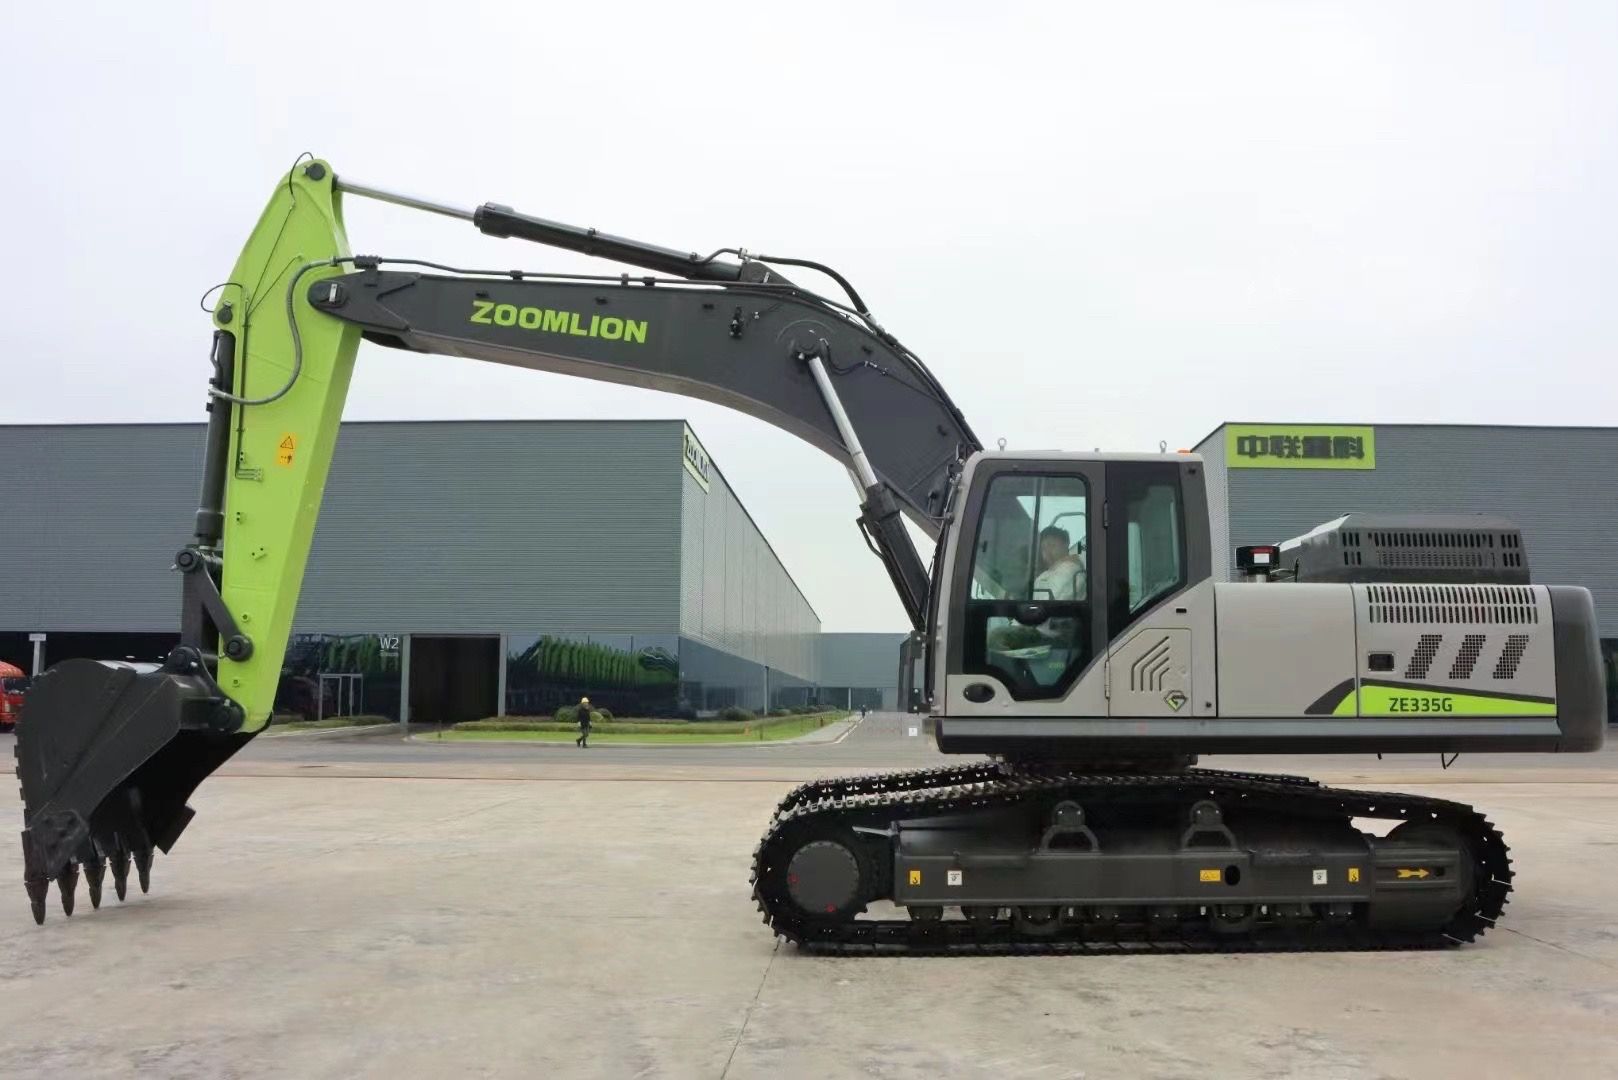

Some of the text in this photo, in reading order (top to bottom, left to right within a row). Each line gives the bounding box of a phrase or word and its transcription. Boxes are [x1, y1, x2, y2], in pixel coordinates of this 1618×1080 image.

[470, 300, 648, 343] ZOOMLION
[380, 637, 399, 649] W2
[1389, 698, 1453, 712] ZE335G
